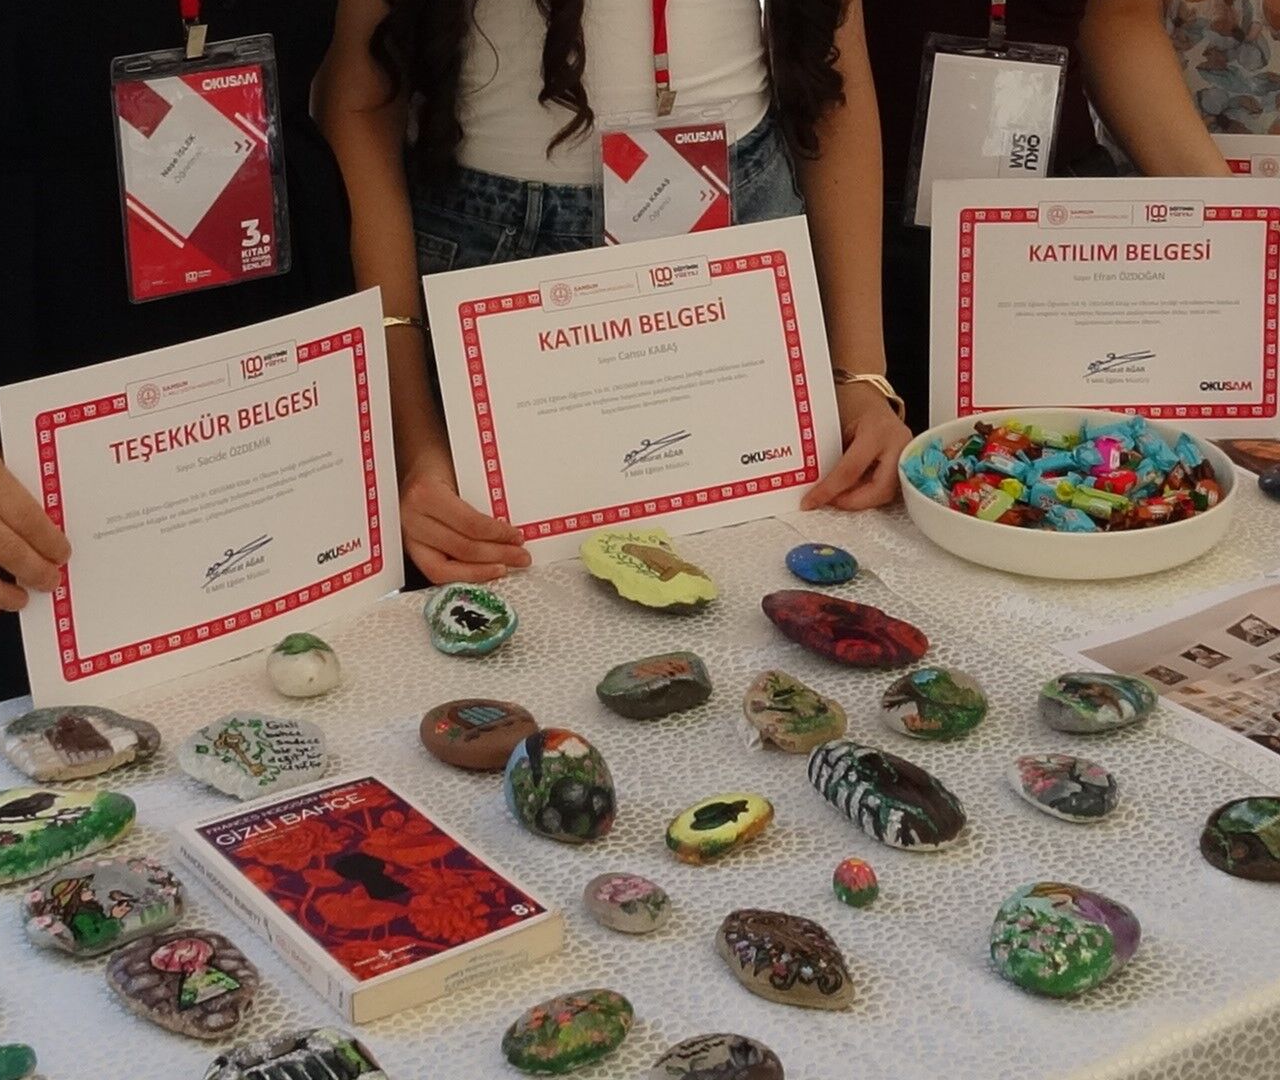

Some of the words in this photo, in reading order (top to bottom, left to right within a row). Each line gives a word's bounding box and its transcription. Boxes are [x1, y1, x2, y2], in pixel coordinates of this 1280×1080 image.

[201, 71, 259, 91] OKUSAM
[674, 129, 725, 145] OKUSAM
[1008, 132, 1026, 170] SAM
[1023, 134, 1041, 172] OKU
[241, 218, 271, 247] 3.
[241, 245, 271, 258] KİTAP
[1028, 244, 1118, 262] KATILIM
[1125, 238, 1211, 262] BELGESİ
[1093, 272, 1117, 281] Efran
[538, 316, 632, 352] KATILIM
[639, 296, 727, 335] BELGESİ
[618, 348, 647, 362] Cansu
[1199, 381, 1253, 392] OKUSAM
[109, 413, 232, 464] TEŞEKKÜR
[238, 381, 320, 431] BELGESİ
[740, 445, 793, 466] OKUSAM
[316, 537, 362, 566] OKUSAM
[206, 813, 261, 835] FRANCES
[216, 816, 278, 846] GİZLİ
[279, 793, 366, 825] BAHÇE
